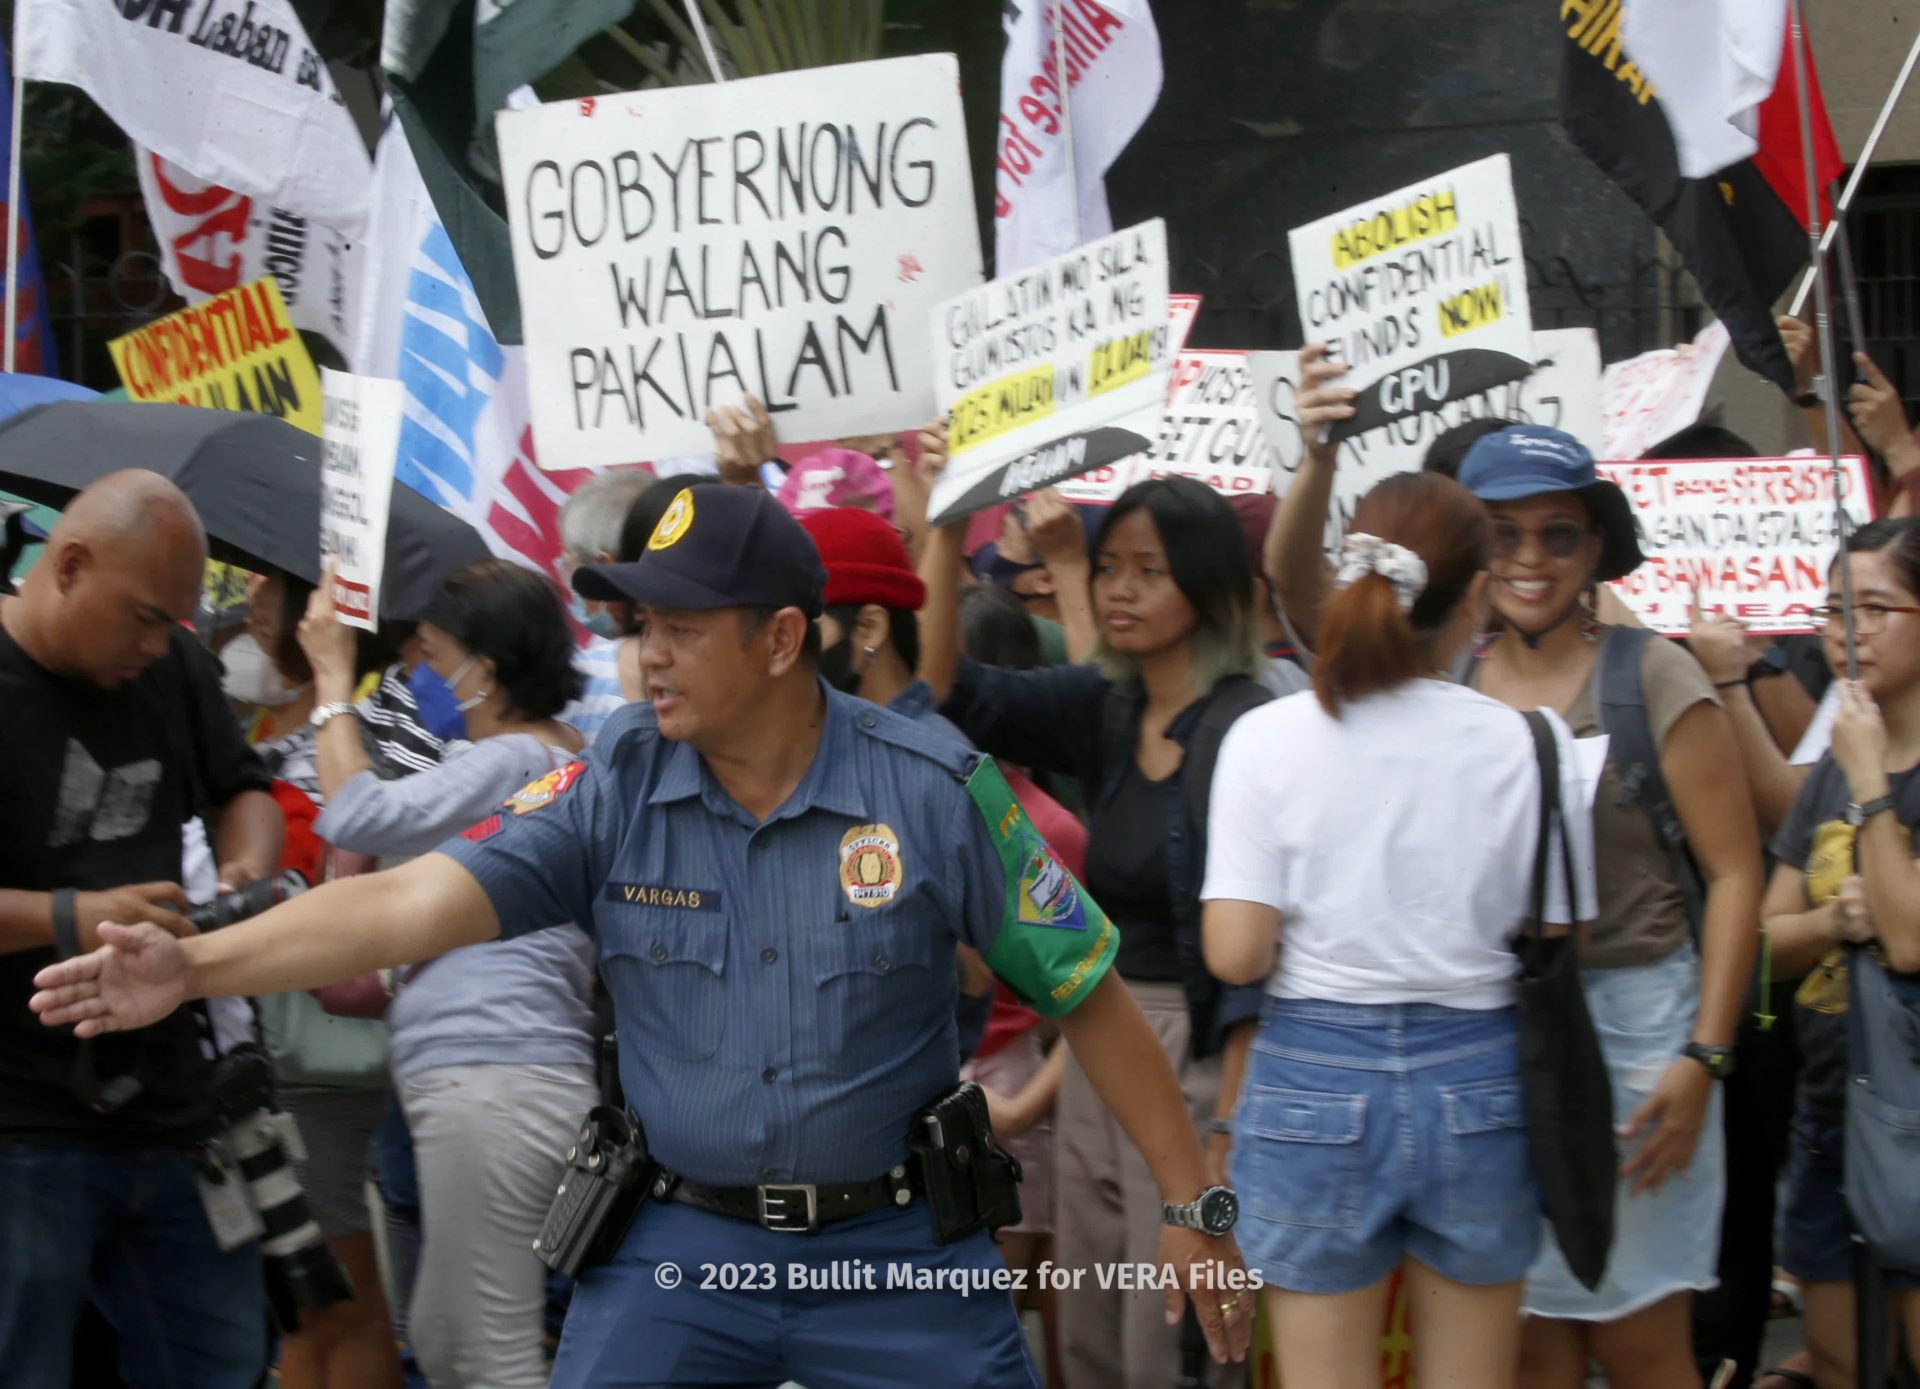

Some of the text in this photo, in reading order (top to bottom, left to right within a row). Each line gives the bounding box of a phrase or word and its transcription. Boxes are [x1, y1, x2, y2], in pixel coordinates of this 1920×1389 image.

[526, 116, 938, 260] GOBYERNONG
[1333, 184, 1456, 262] ABOLISH
[610, 225, 852, 330] WALANG
[1307, 221, 1513, 328] CONFIDENTIAL
[122, 280, 290, 399] CONFIDENTIAL
[569, 303, 900, 432] PAKIALAM
[1647, 553, 1822, 593] BAWASAN
[624, 884, 701, 909] VARGAS
